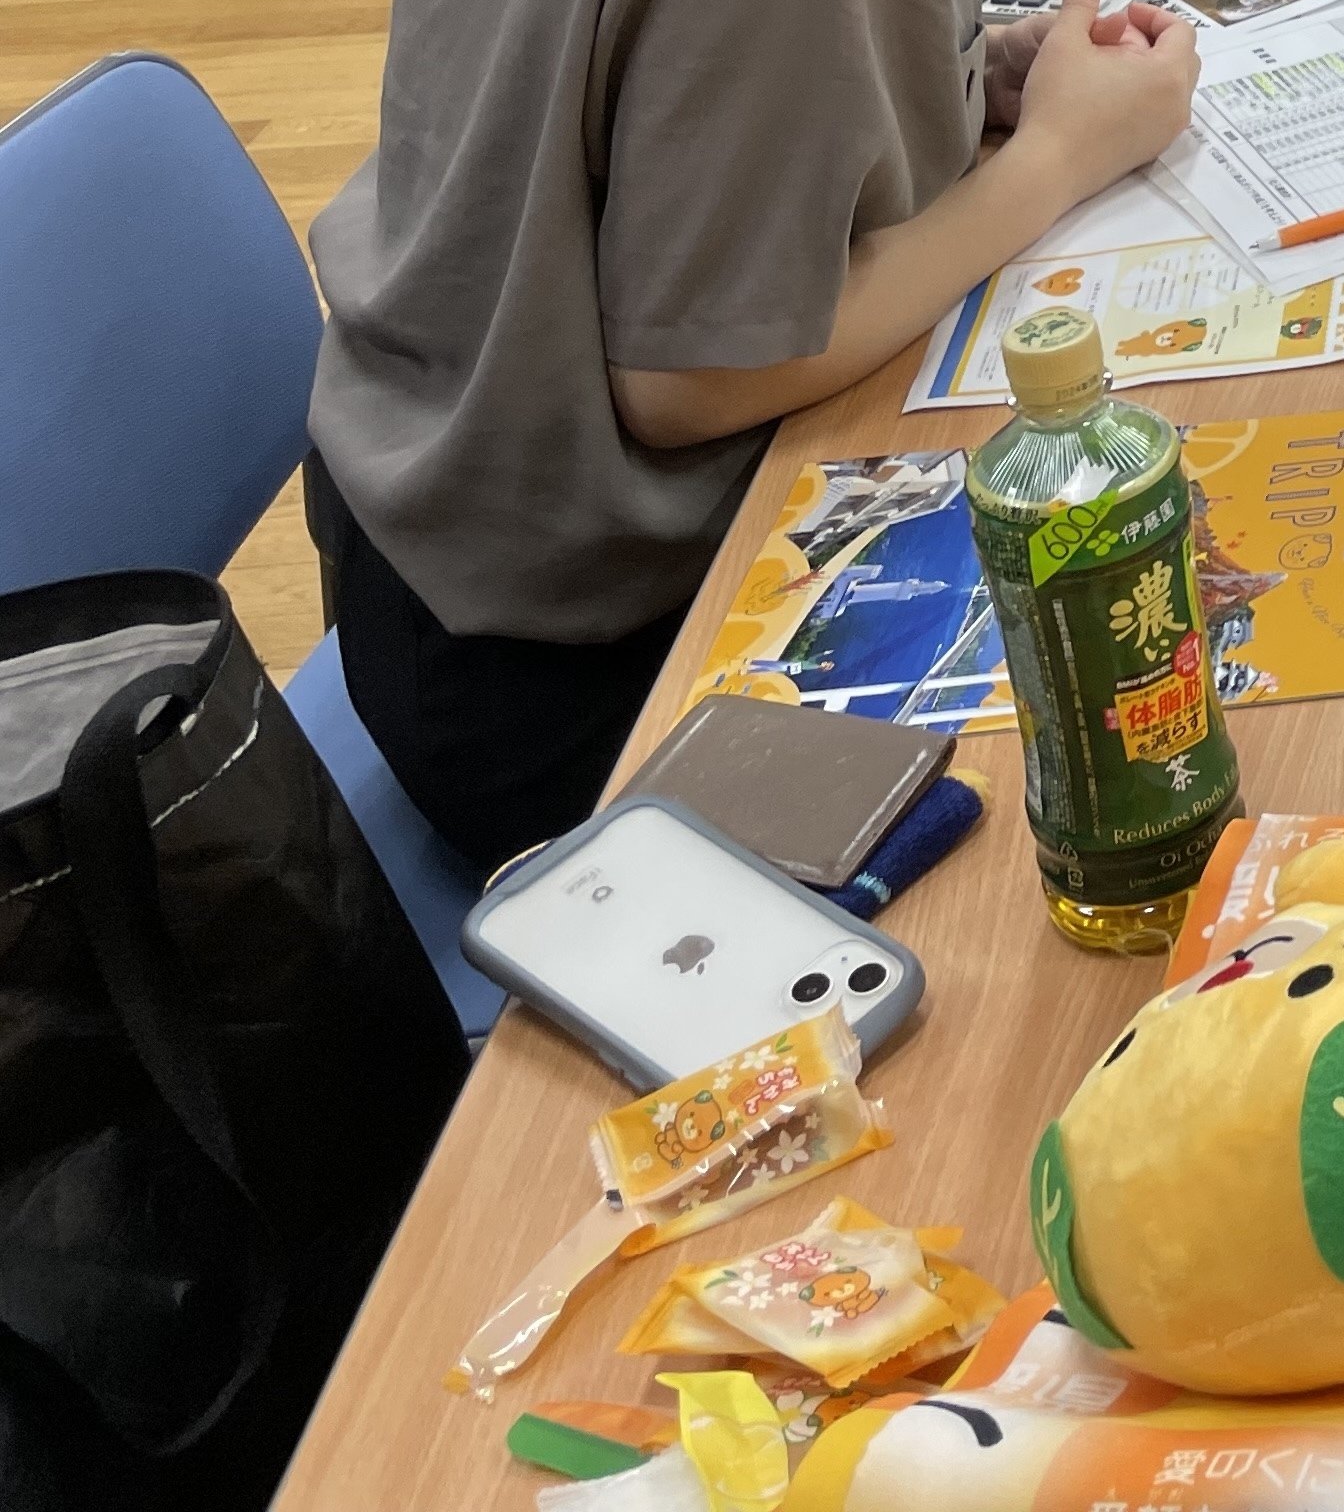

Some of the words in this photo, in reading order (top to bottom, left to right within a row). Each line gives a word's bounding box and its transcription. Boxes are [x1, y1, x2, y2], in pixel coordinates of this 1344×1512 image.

[1121, 496, 1176, 545] 伊藤園
[1108, 559, 1188, 663] 濃い
[1126, 672, 1203, 728] 体脂肪
[1135, 709, 1203, 756] を減らす
[1165, 752, 1200, 792] 茶
[1112, 813, 1190, 846] Reduces
[1192, 786, 1226, 818] Body
[1186, 826, 1223, 857] Och
